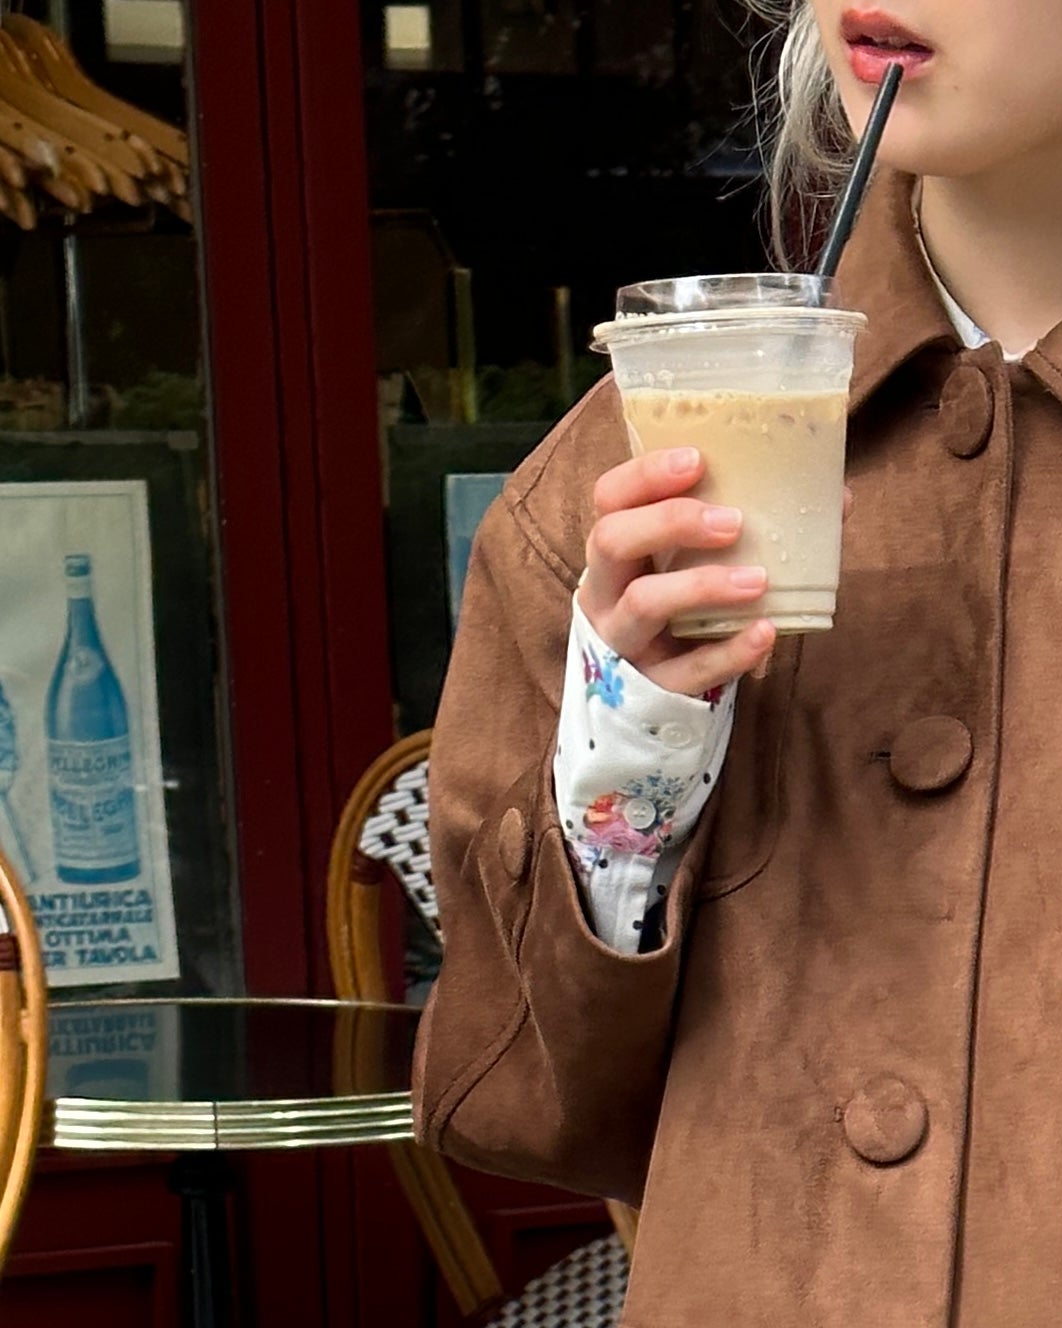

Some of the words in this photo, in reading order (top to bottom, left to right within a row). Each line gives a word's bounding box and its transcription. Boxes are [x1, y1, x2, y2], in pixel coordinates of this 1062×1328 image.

[45, 927, 130, 947] OTTIMA
[41, 951, 66, 967] ER
[75, 945, 157, 965] TAVOLA
